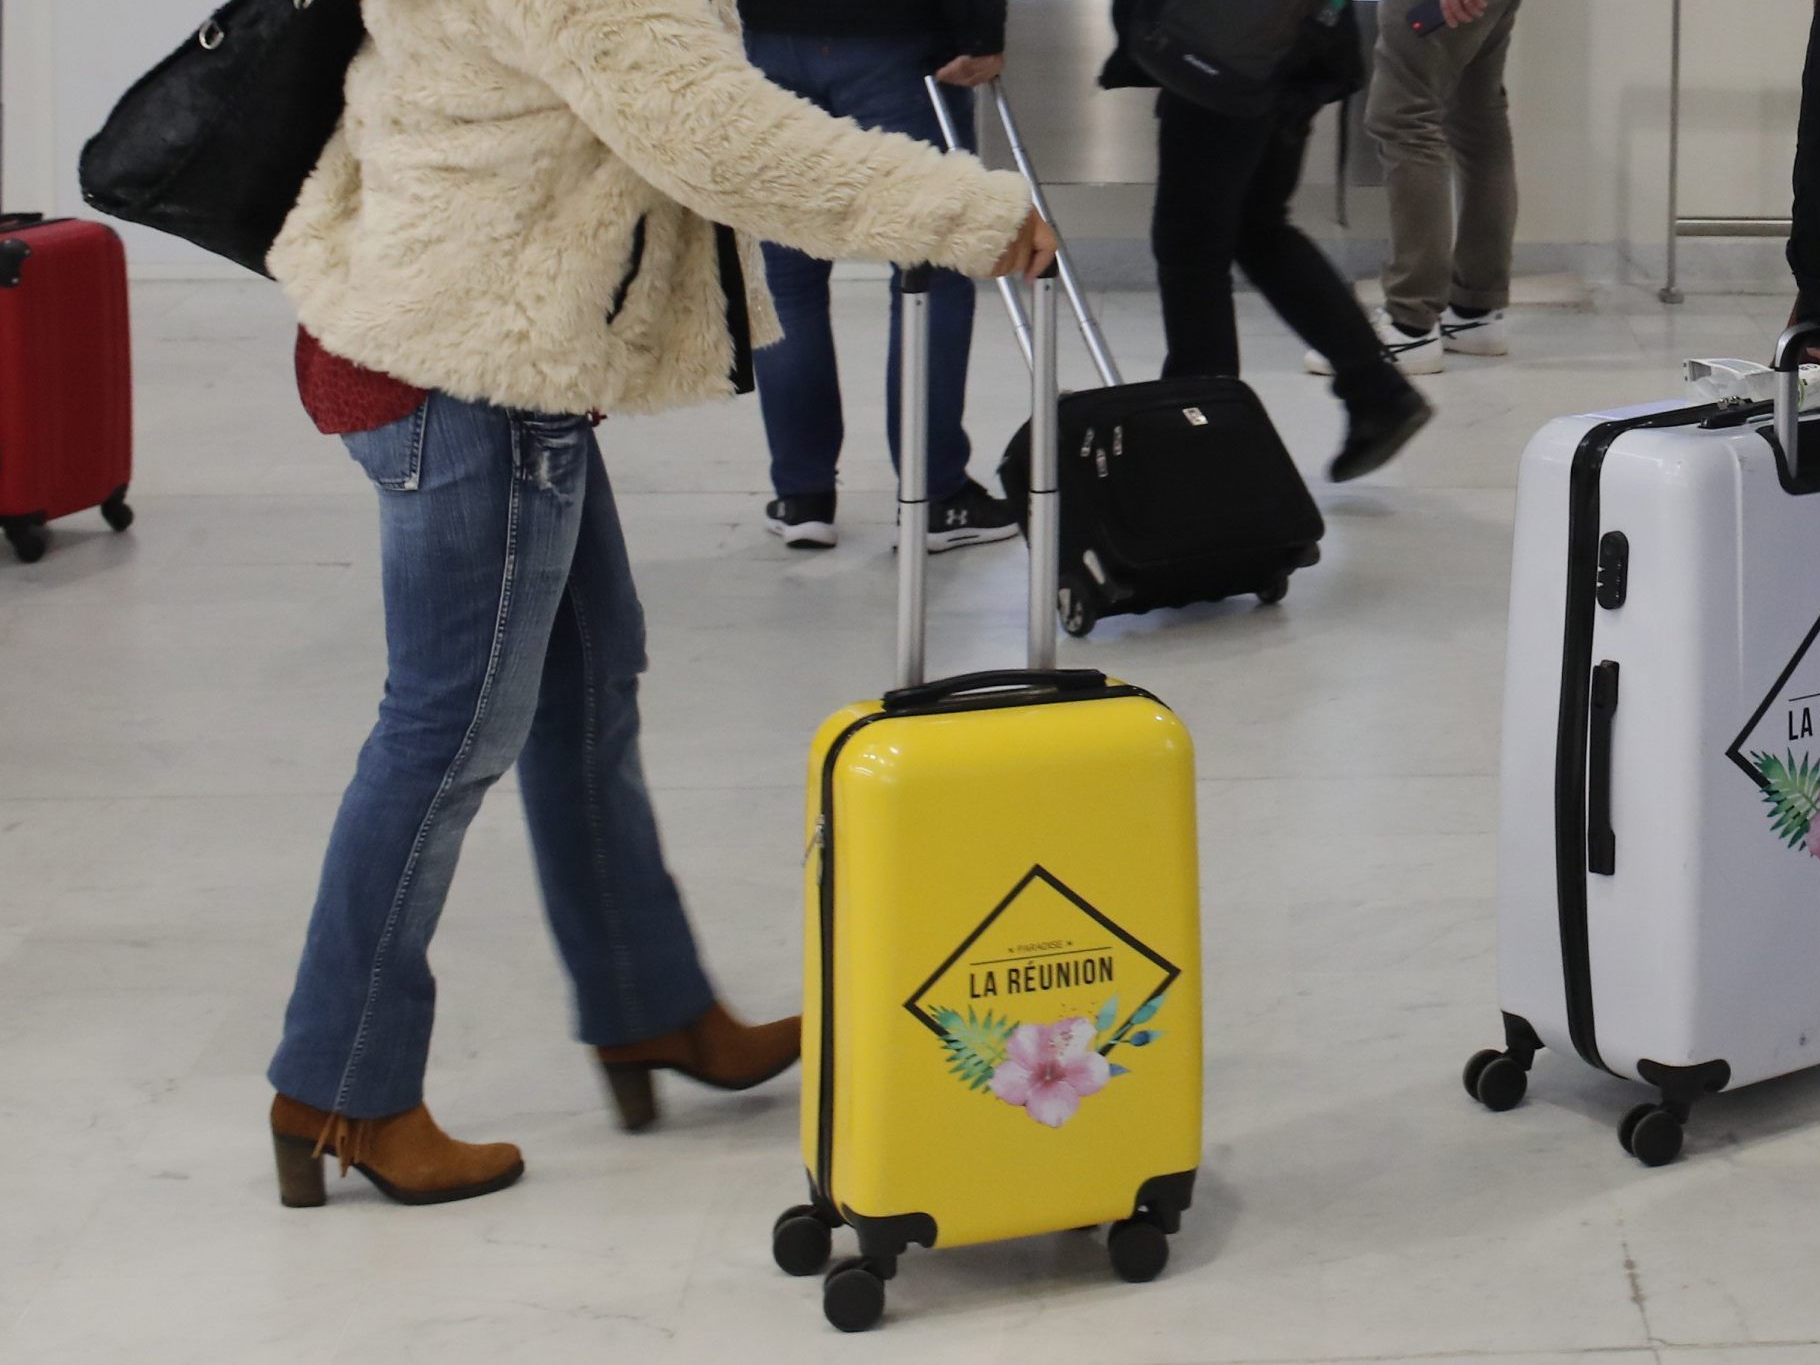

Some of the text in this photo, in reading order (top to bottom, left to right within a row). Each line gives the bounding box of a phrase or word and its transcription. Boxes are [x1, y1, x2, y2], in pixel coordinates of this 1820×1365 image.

[1788, 707, 1813, 740] LA
[969, 956, 1113, 999] LA RÉUNION
